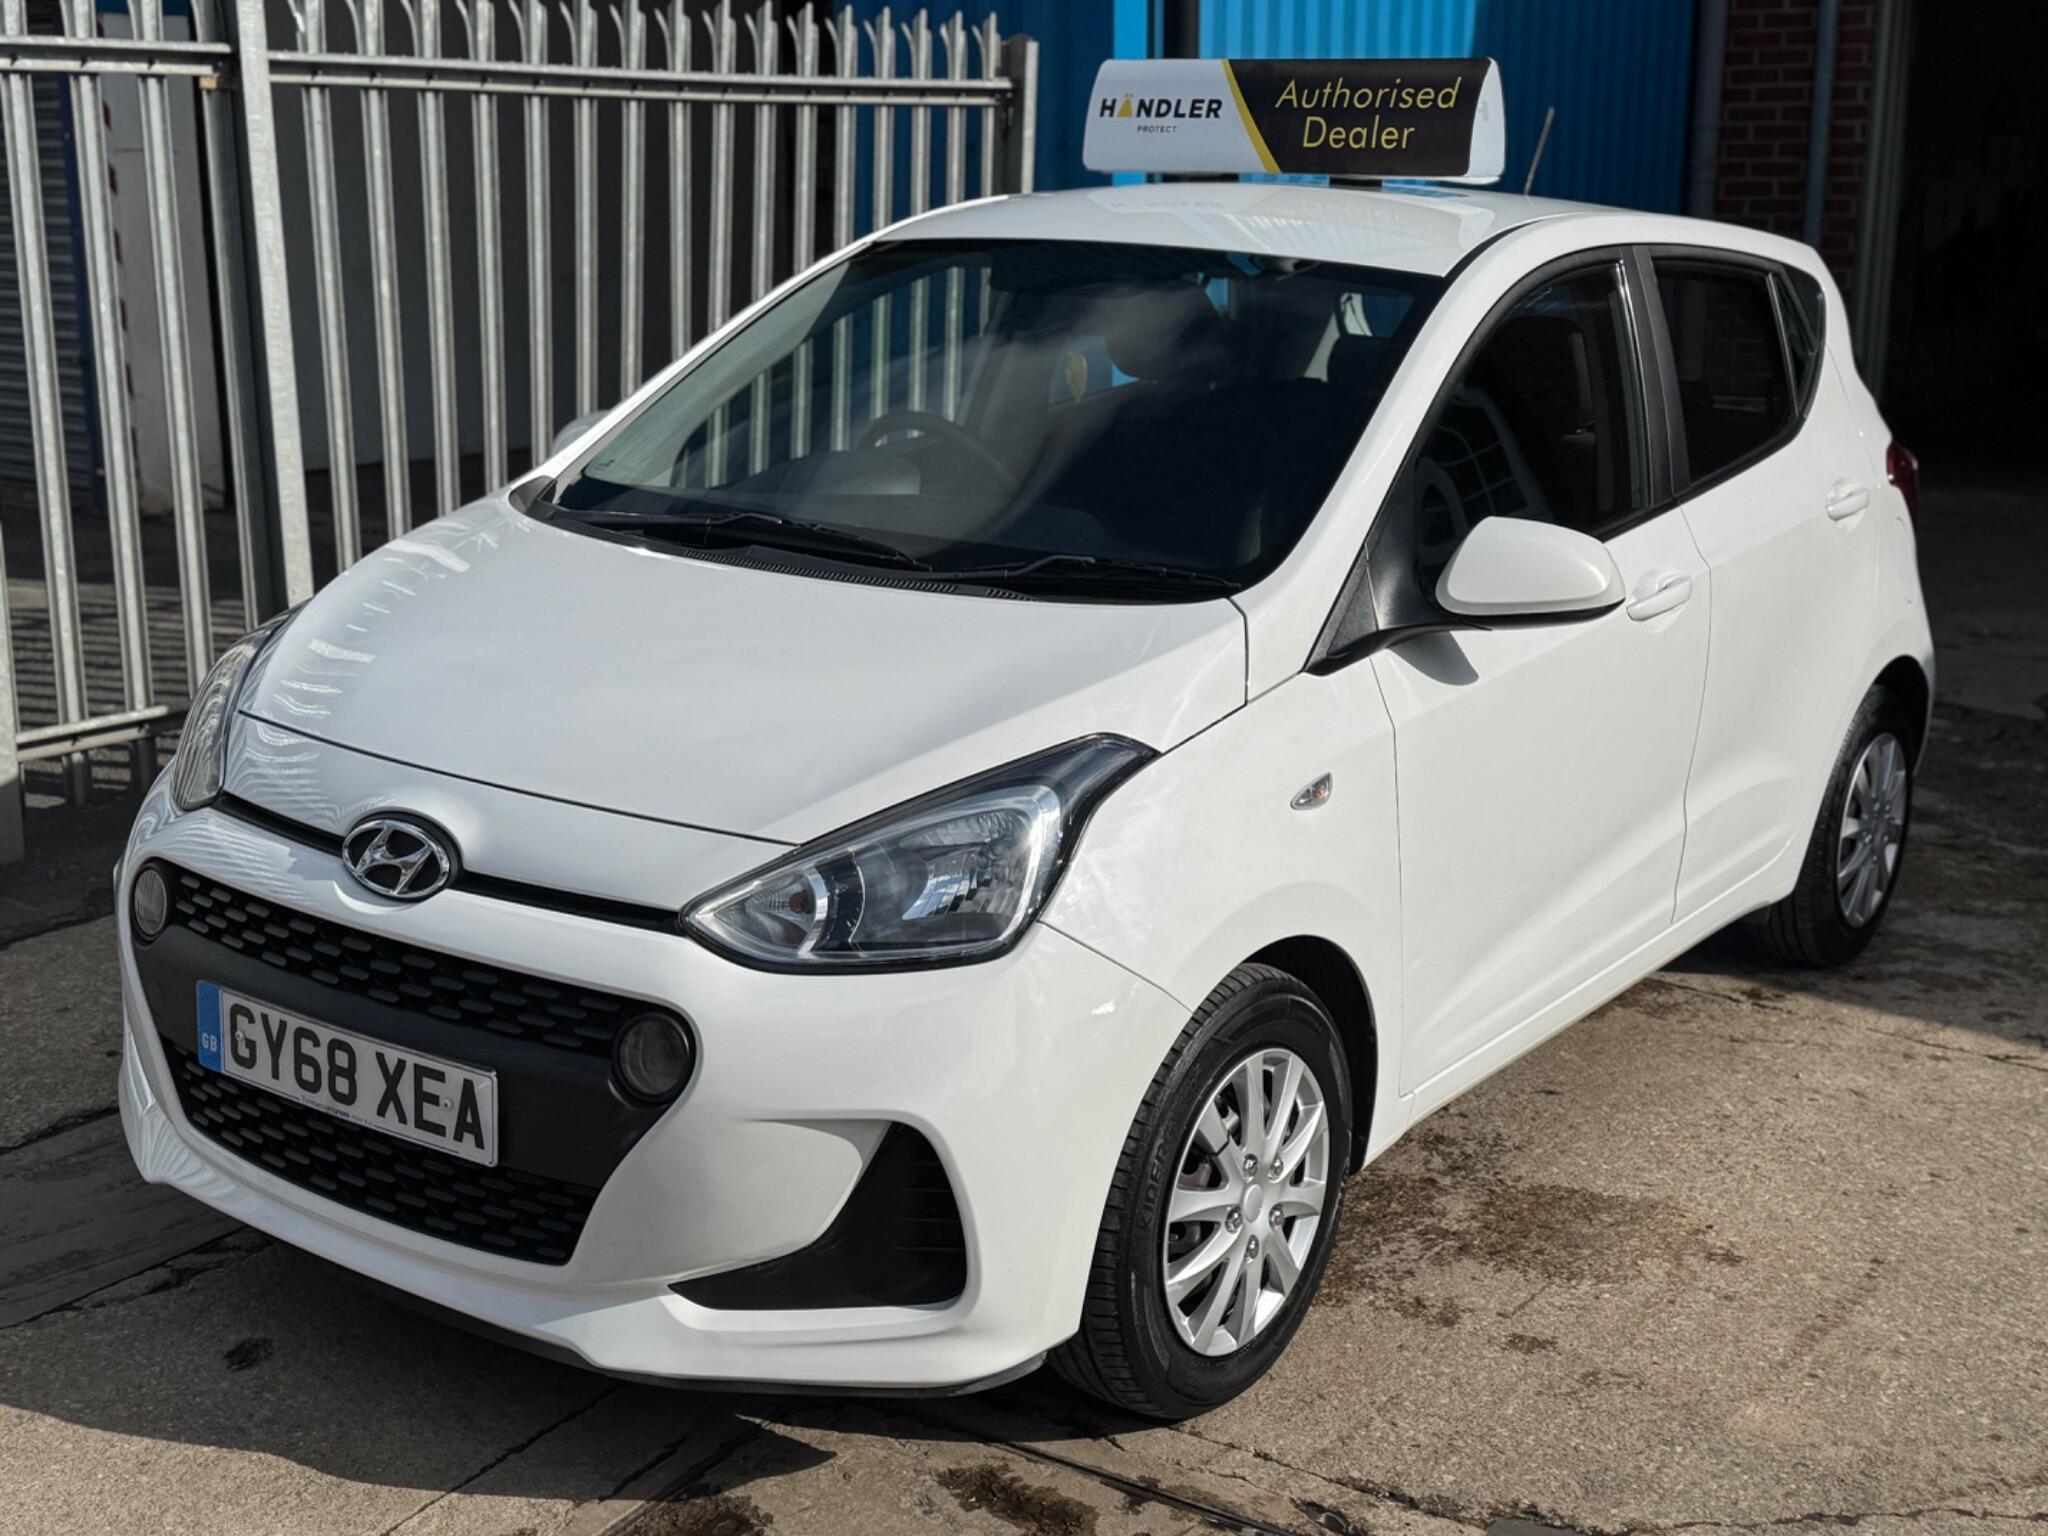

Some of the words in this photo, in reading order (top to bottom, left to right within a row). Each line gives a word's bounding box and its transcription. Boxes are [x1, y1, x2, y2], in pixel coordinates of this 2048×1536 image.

[1275, 76, 1462, 109] Authorised
[1136, 125, 1178, 133] PROTECT
[1303, 114, 1415, 149] Dealer
[202, 1032, 218, 1052] GB
[229, 1002, 358, 1106] GY68
[375, 1051, 485, 1150] XEA
